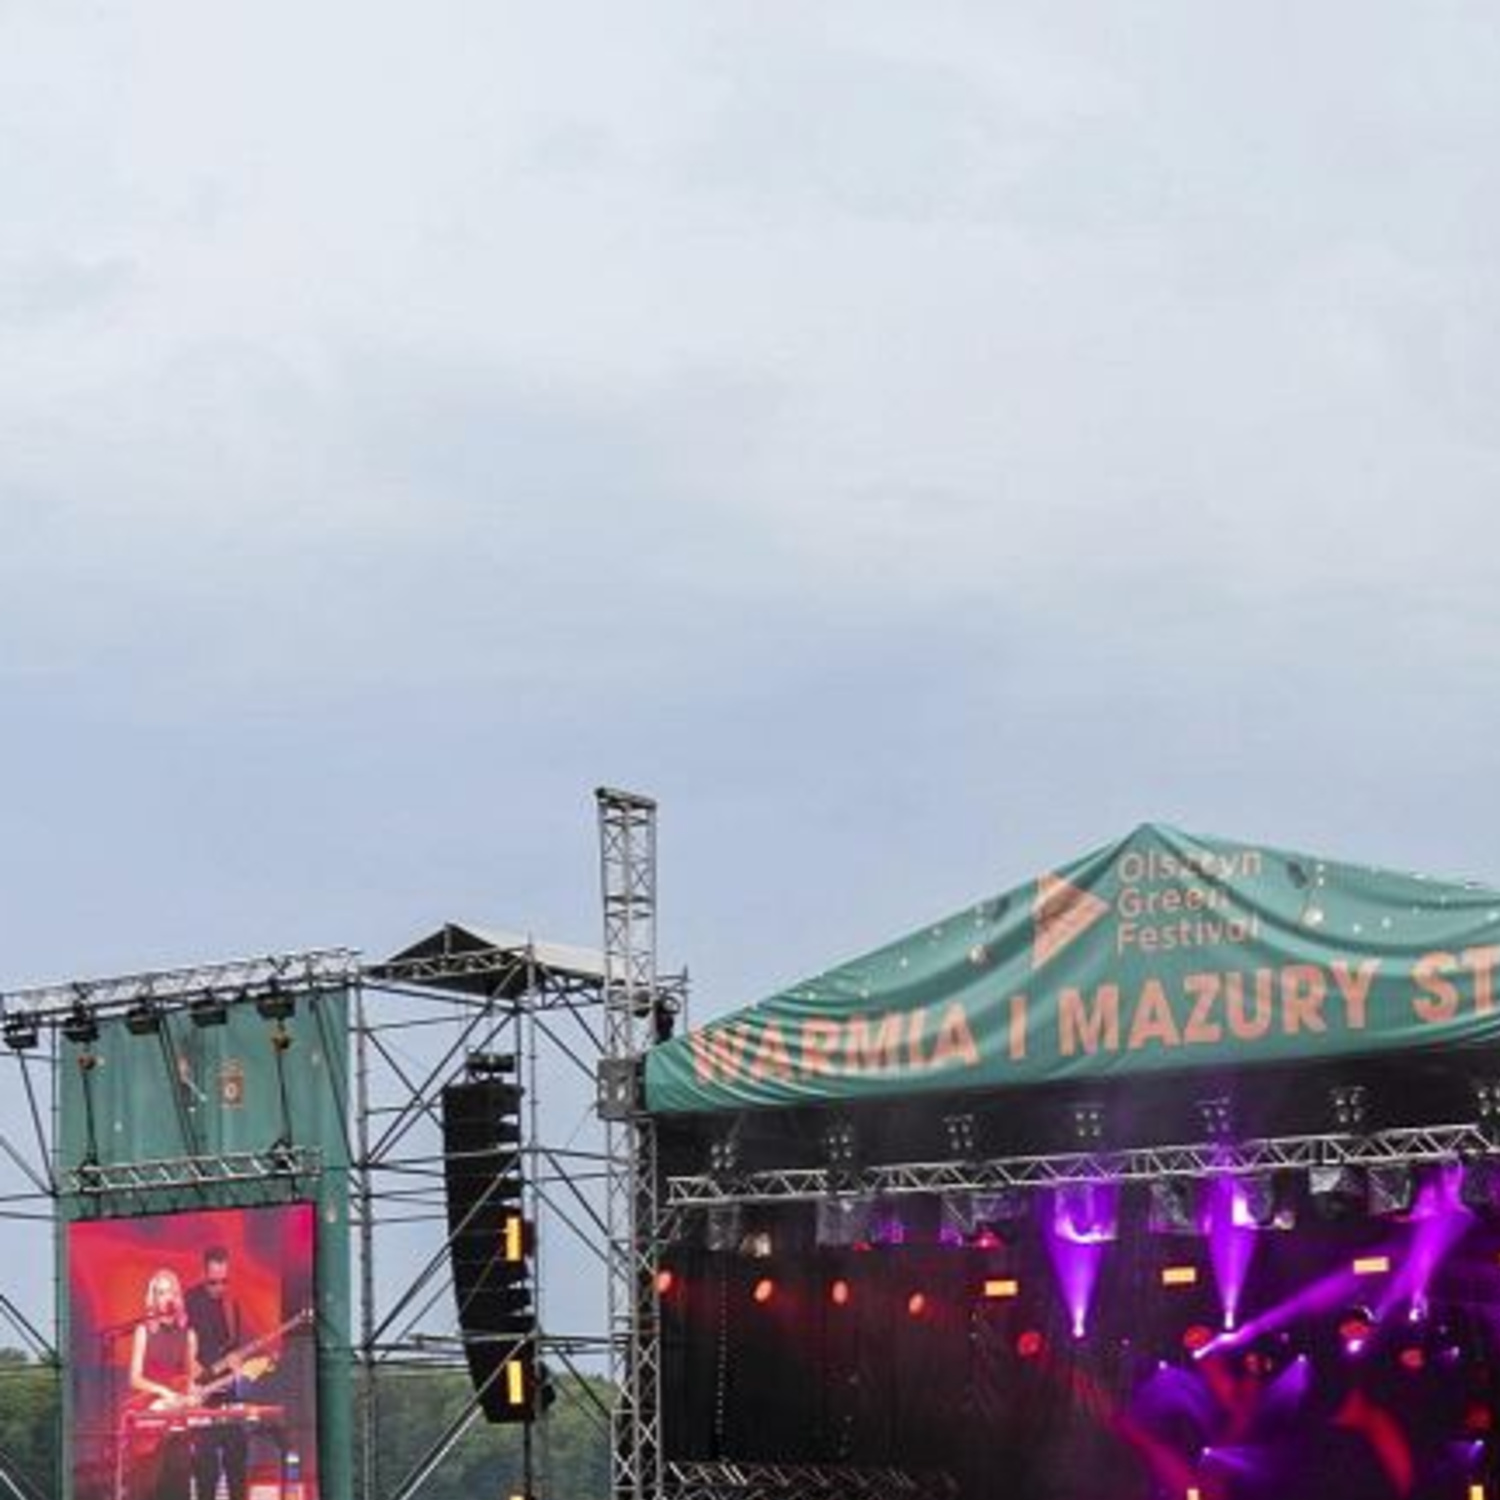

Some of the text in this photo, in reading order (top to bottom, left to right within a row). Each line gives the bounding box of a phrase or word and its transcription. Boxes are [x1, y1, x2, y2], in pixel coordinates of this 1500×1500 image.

[1117, 912, 1259, 954] Festival
[690, 1000, 980, 1083] WARMIA
[1008, 995, 1028, 1061] I
[1057, 957, 1382, 1057] MAZURY
